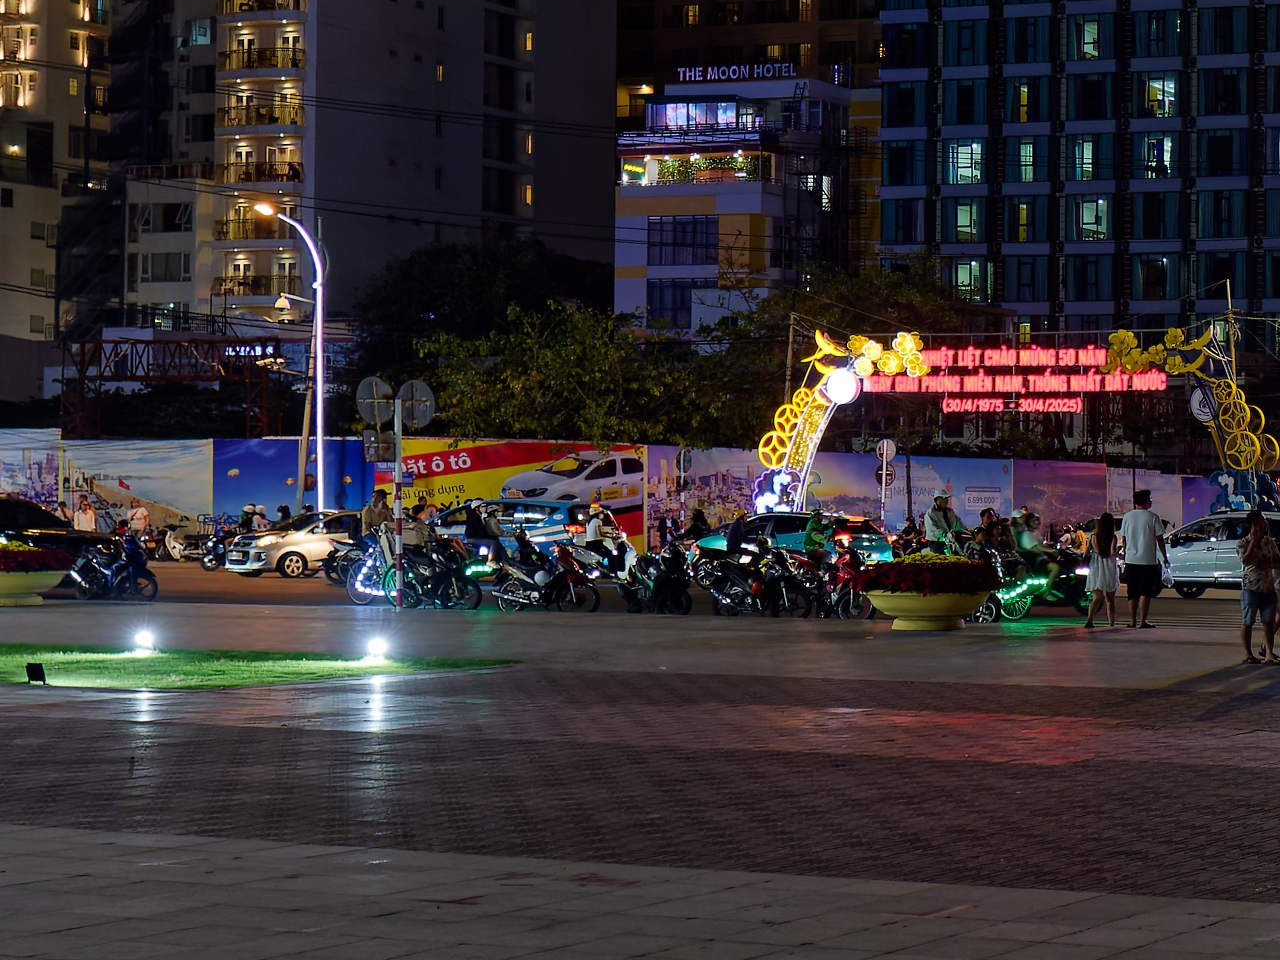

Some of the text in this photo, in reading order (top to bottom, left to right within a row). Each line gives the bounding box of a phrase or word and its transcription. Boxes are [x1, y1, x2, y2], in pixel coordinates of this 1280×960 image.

[678, 63, 797, 81] THE MOON HOTEL
[984, 345, 1017, 367] CHÀO
[1058, 348, 1076, 367] 50
[1078, 344, 1107, 367] NĂM
[995, 374, 1026, 394] NAM,
[942, 397, 1004, 414] (30/4/1975
[1018, 397, 1083, 414] 30/4/2025)
[431, 456, 445, 472] ô
[448, 452, 471, 470] tô
